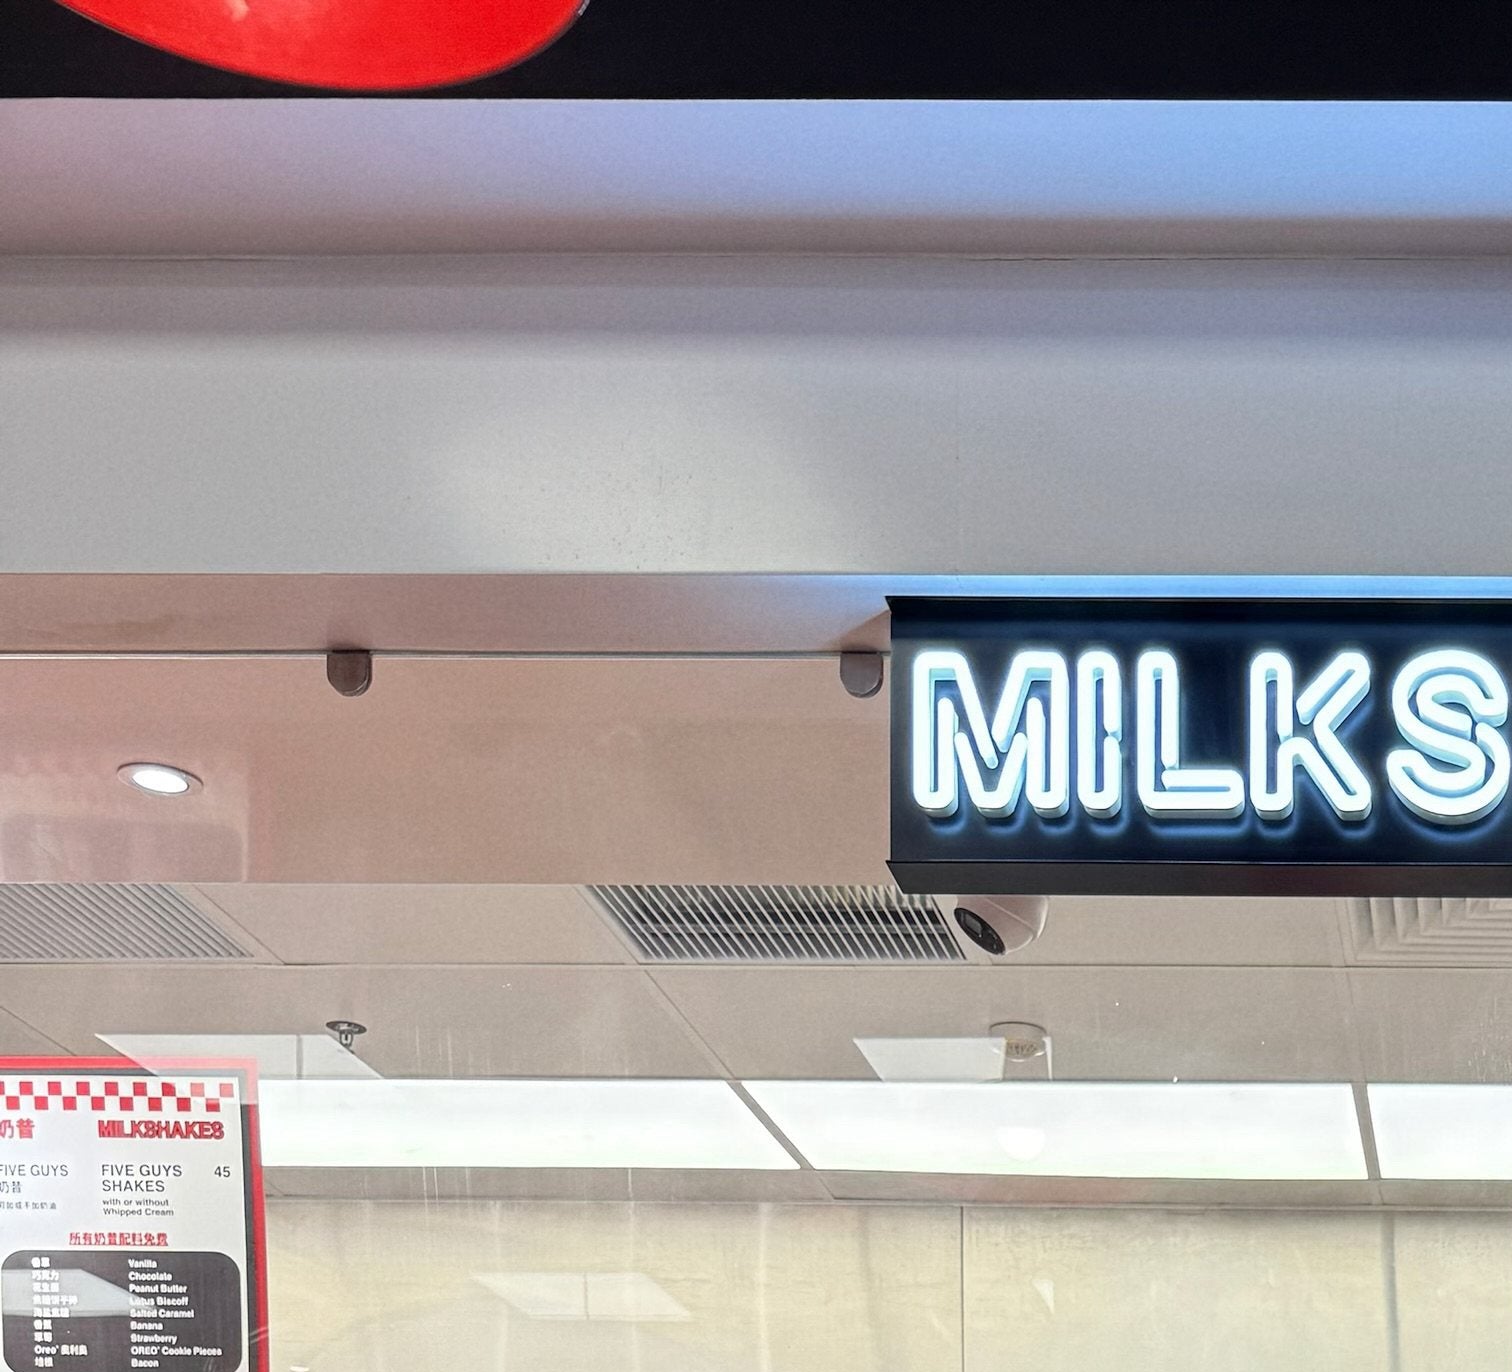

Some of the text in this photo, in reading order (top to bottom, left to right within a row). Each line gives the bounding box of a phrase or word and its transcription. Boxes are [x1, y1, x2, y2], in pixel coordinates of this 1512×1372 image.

[97, 1119, 225, 1140] MILKSHAKES
[30, 1164, 70, 1177] GUYS
[101, 1164, 183, 1177] FIVE GUYS
[213, 1166, 232, 1178] 45
[102, 1179, 166, 1193] SHAKES
[102, 1198, 121, 1206] with
[135, 1198, 170, 1207] without
[103, 1207, 175, 1218] Whipped Cream
[128, 1271, 173, 1281] Chocolate
[129, 1284, 188, 1294] Peanut Butter
[158, 1309, 194, 1318] Caramel
[130, 1333, 178, 1344] Strawberry
[161, 1346, 192, 1356] Cookie
[131, 1358, 160, 1368] Bacon
